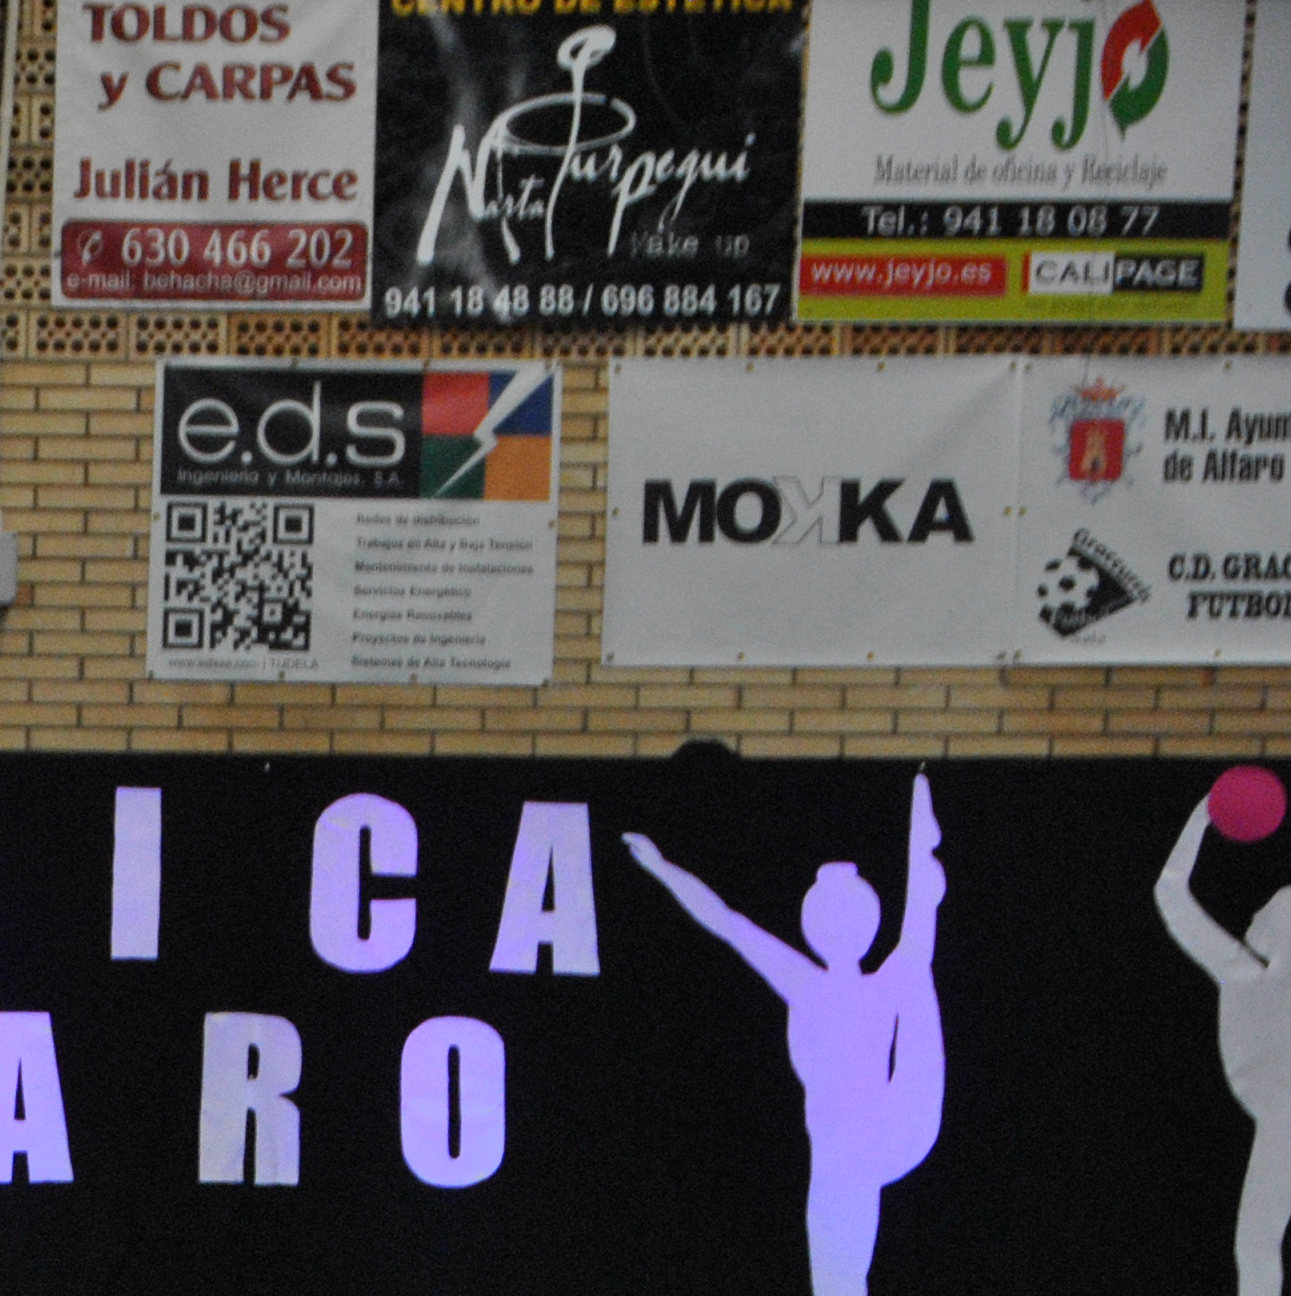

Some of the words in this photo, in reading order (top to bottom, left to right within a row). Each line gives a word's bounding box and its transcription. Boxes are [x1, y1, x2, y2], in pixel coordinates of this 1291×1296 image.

[83, 4, 291, 43] TOLDOS
[98, 72, 128, 110] y
[145, 60, 357, 101] CARPAS
[74, 157, 210, 200] Julián
[228, 158, 359, 201] Herce
[874, 154, 958, 185] Material
[964, 155, 986, 183] de
[992, 155, 1057, 184] oficina
[1063, 162, 1075, 188] y
[1081, 155, 1169, 188] Reciclaje
[862, 205, 929, 235] Tel.:
[943, 205, 1002, 235] 941
[1020, 205, 1056, 235] 18
[1067, 205, 1108, 235] 08
[1119, 205, 1161, 235] 77
[121, 227, 191, 267] 630
[203, 228, 272, 268] 466
[285, 228, 353, 269] 202
[66, 271, 136, 289] e-mail:
[811, 257, 993, 287] www.jeyjo.es
[384, 286, 437, 318] 941
[450, 285, 484, 316] 18
[494, 284, 530, 317] 48
[538, 284, 575, 316] 88
[600, 284, 655, 316] 696
[663, 284, 718, 315] 884
[729, 284, 781, 315] 167
[178, 380, 407, 466] e.d.s
[1164, 407, 1216, 441] M.I.
[1164, 449, 1194, 483] de
[1202, 448, 1286, 483] Alfaro
[1168, 552, 1216, 582] C.D.
